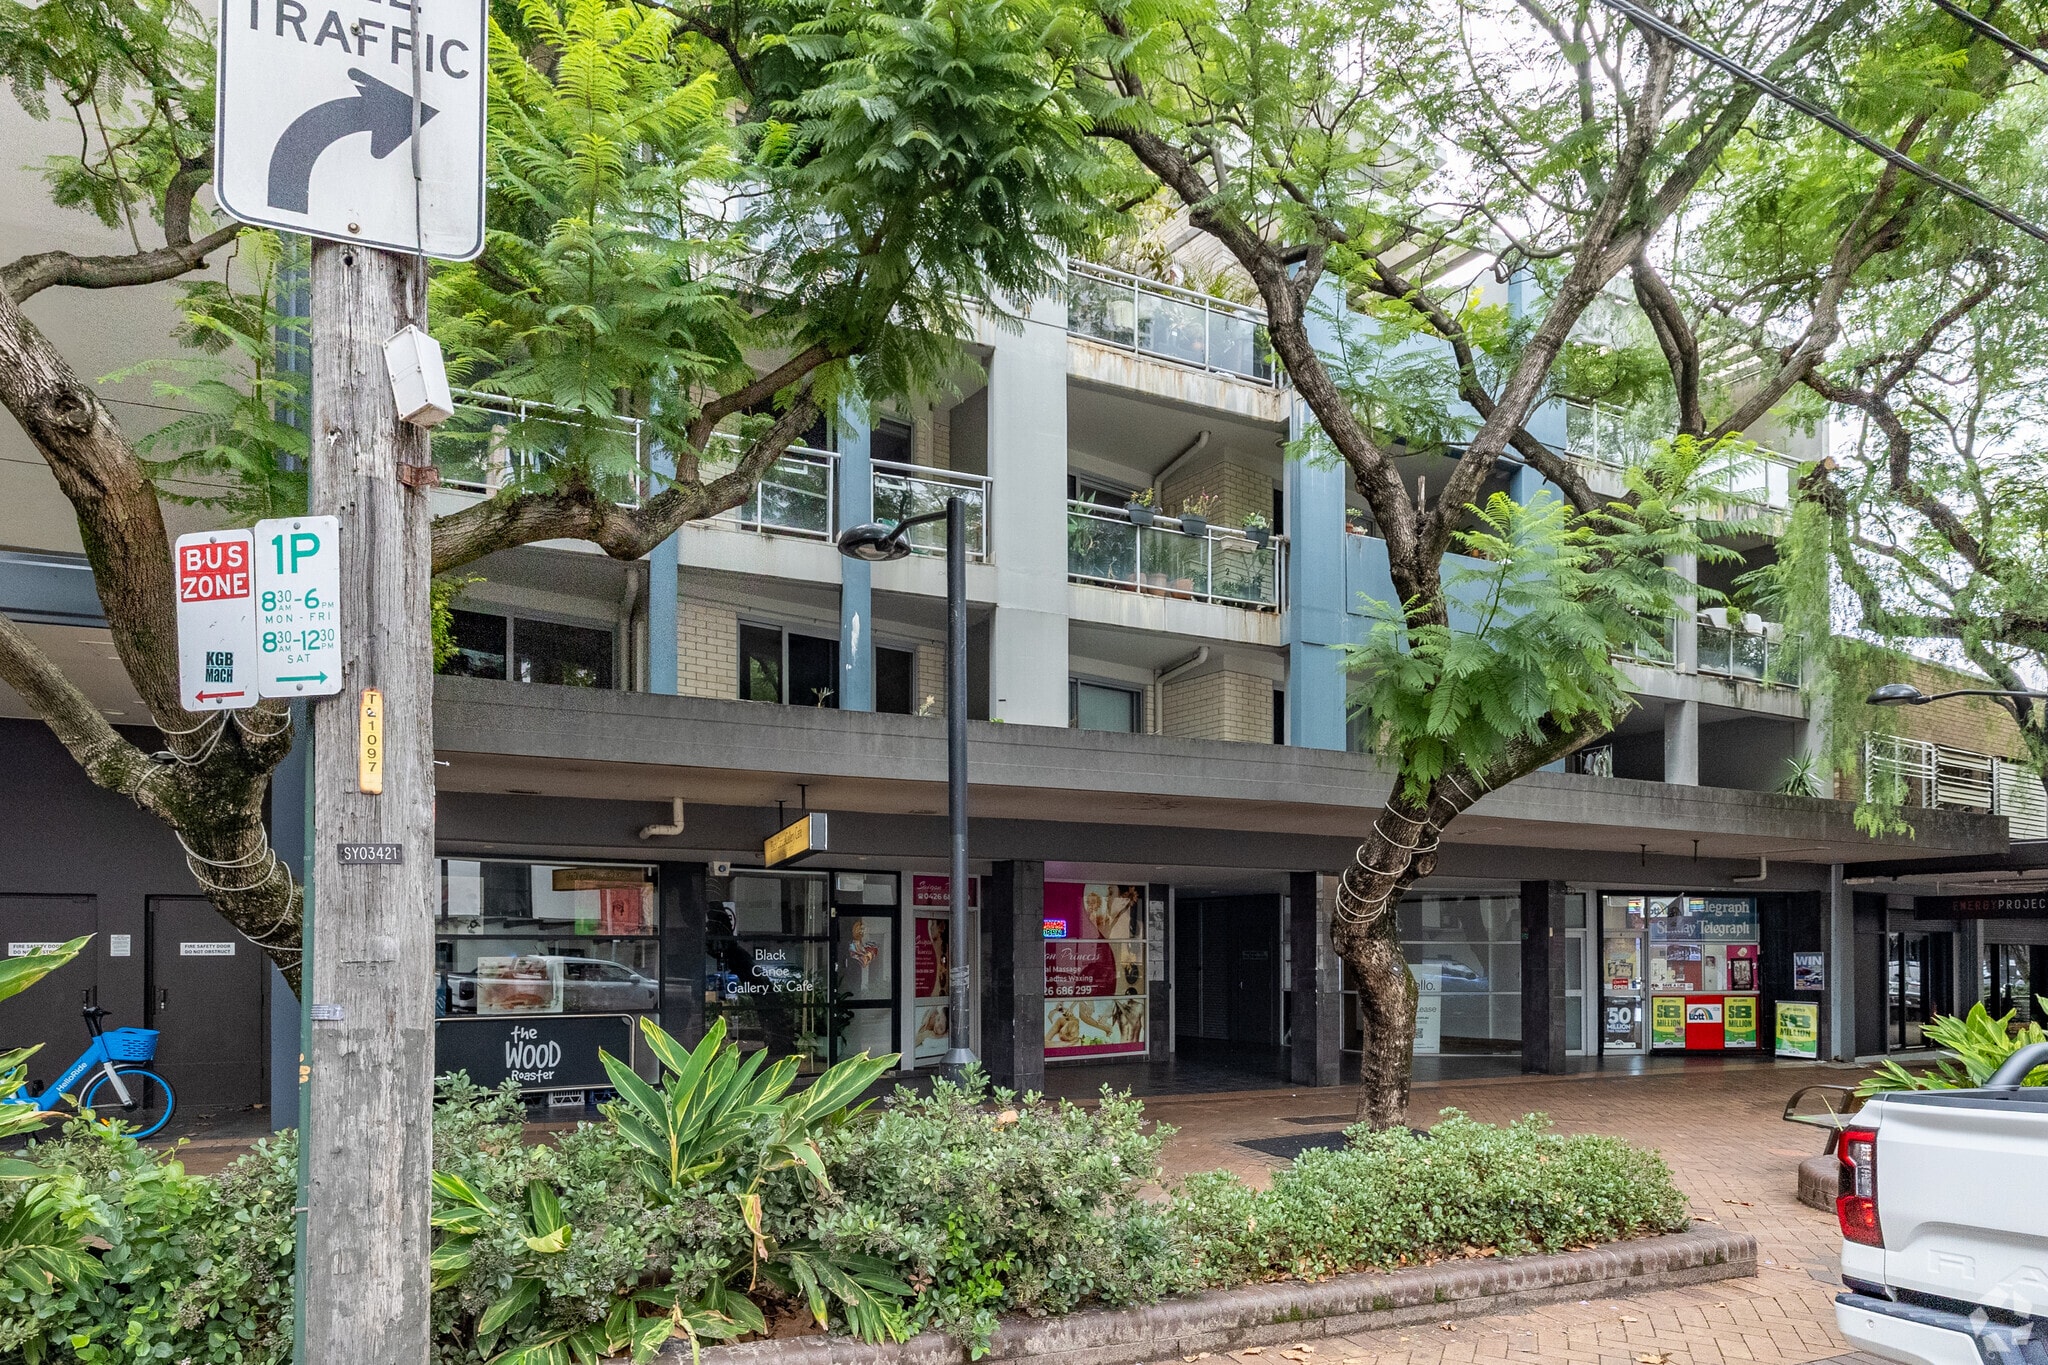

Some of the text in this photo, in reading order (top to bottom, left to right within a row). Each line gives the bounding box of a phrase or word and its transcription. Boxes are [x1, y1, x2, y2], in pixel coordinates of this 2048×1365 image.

[185, 545, 244, 571] BUS
[271, 532, 321, 575] 1P
[182, 572, 248, 599] ZONE
[265, 613, 293, 624] MON
[309, 611, 331, 621] FRI
[206, 651, 233, 666] KGB
[287, 653, 310, 664] SAT
[1697, 920, 1750, 936] Telegraph
[755, 949, 786, 961] Black
[1061, 947, 1100, 961] Princess
[1796, 956, 1822, 966] WIN
[752, 965, 789, 977] Canoe
[1053, 966, 1081, 974] Massage
[727, 982, 769, 995] Gallery
[773, 982, 782, 992] &
[1056, 986, 1074, 995] 686
[1075, 986, 1092, 995] 299
[1416, 979, 1436, 991] ello.
[511, 1026, 538, 1044] the
[505, 1040, 561, 1069] WOOD
[56, 1062, 88, 1092] HelloRide
[511, 1070, 554, 1083] Roaster
